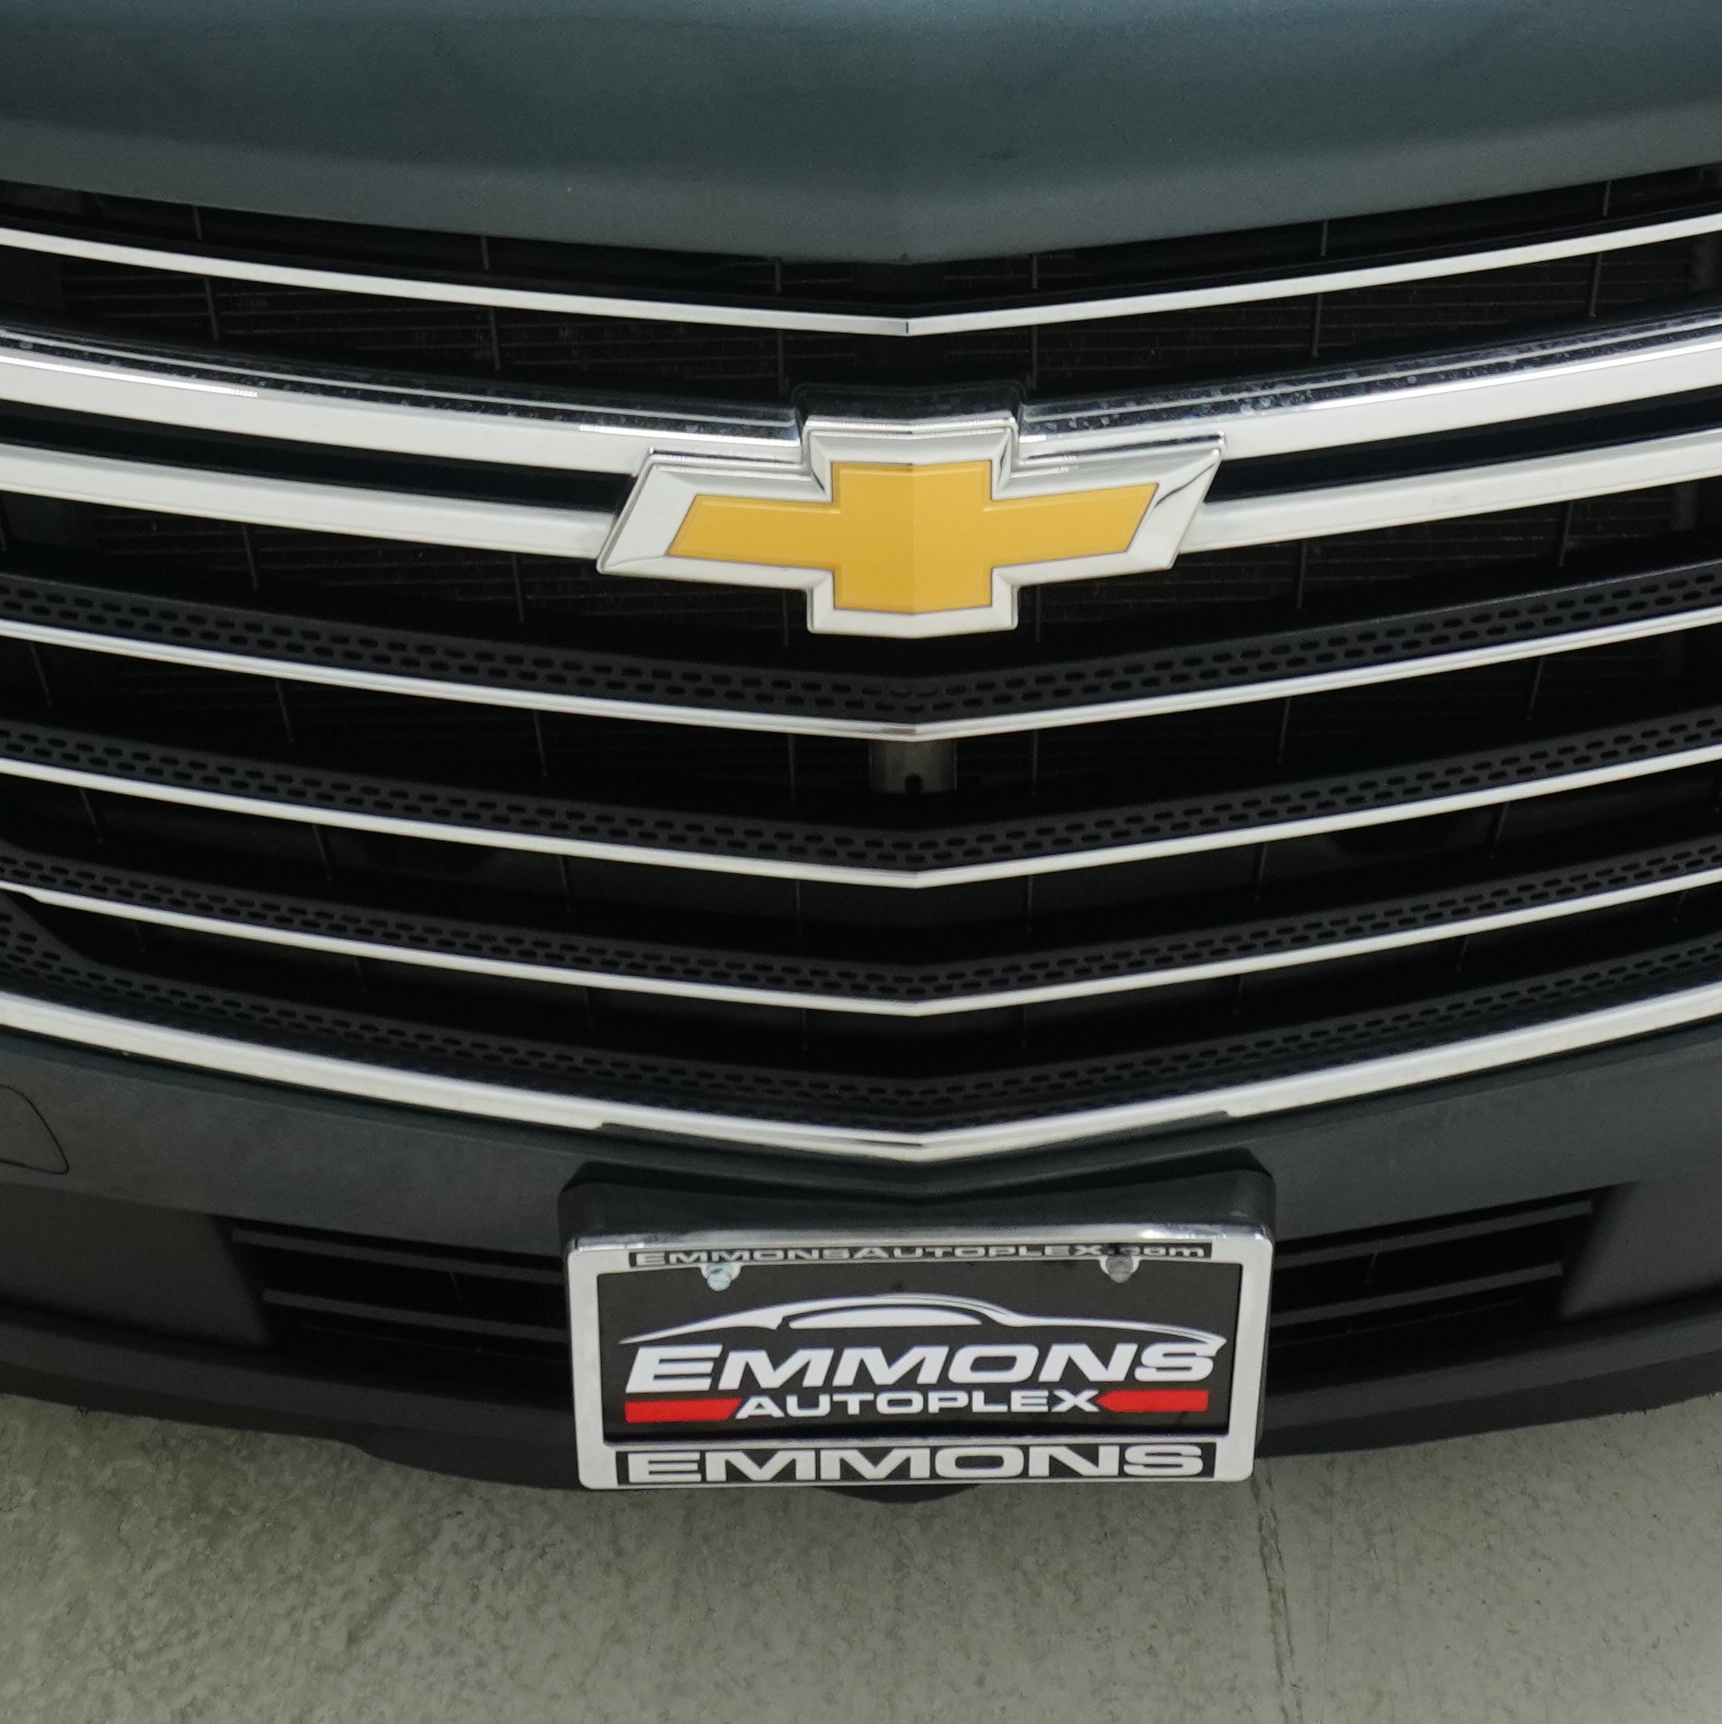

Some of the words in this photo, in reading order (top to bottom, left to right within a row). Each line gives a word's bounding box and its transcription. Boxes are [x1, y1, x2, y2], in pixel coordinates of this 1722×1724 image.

[625, 1342, 1218, 1394] EMMONS
[735, 1388, 1101, 1420] AUTOPLEX
[627, 1443, 1205, 1484] EMMONS
